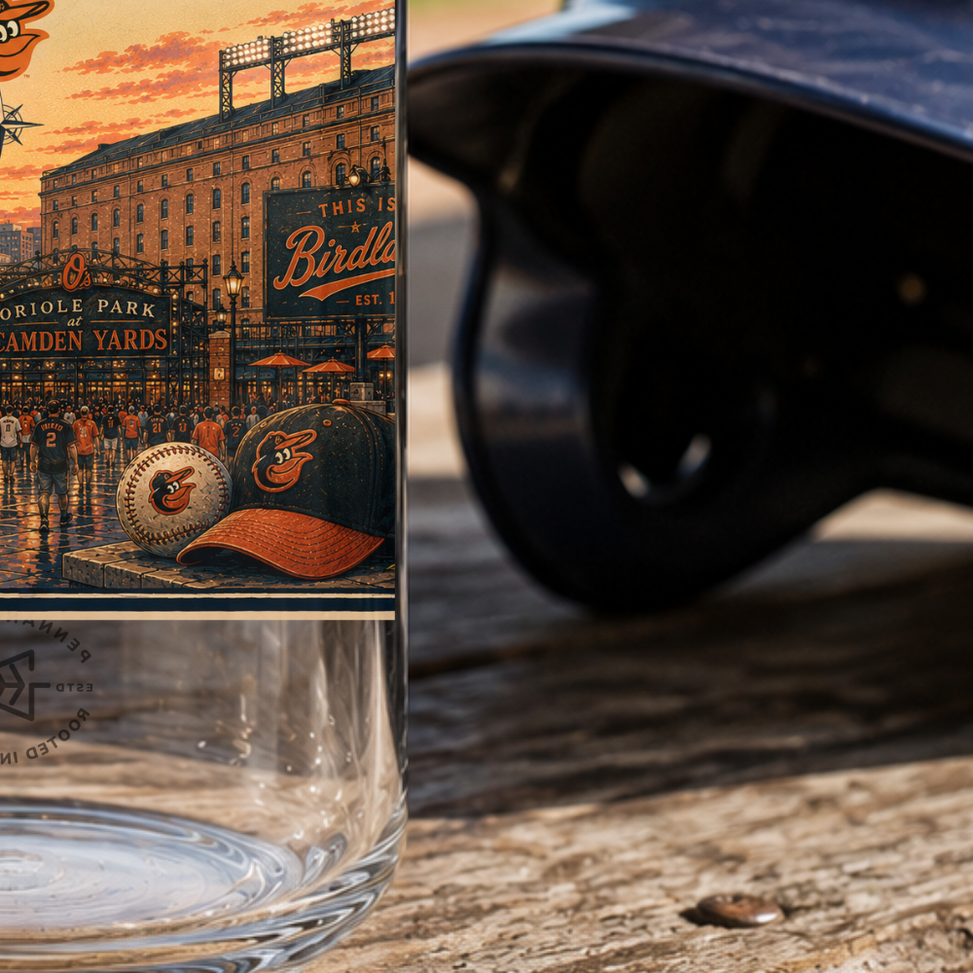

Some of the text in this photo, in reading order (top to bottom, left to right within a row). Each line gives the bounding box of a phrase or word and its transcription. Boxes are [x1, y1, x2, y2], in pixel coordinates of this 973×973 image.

[318, 197, 395, 218] THIS IS
[355, 294, 383, 306] EST.
[0, 298, 156, 321] ORIOLE PARK
[66, 316, 84, 327] at
[93, 328, 168, 351] YARDS
[46, 432, 57, 447] 2
